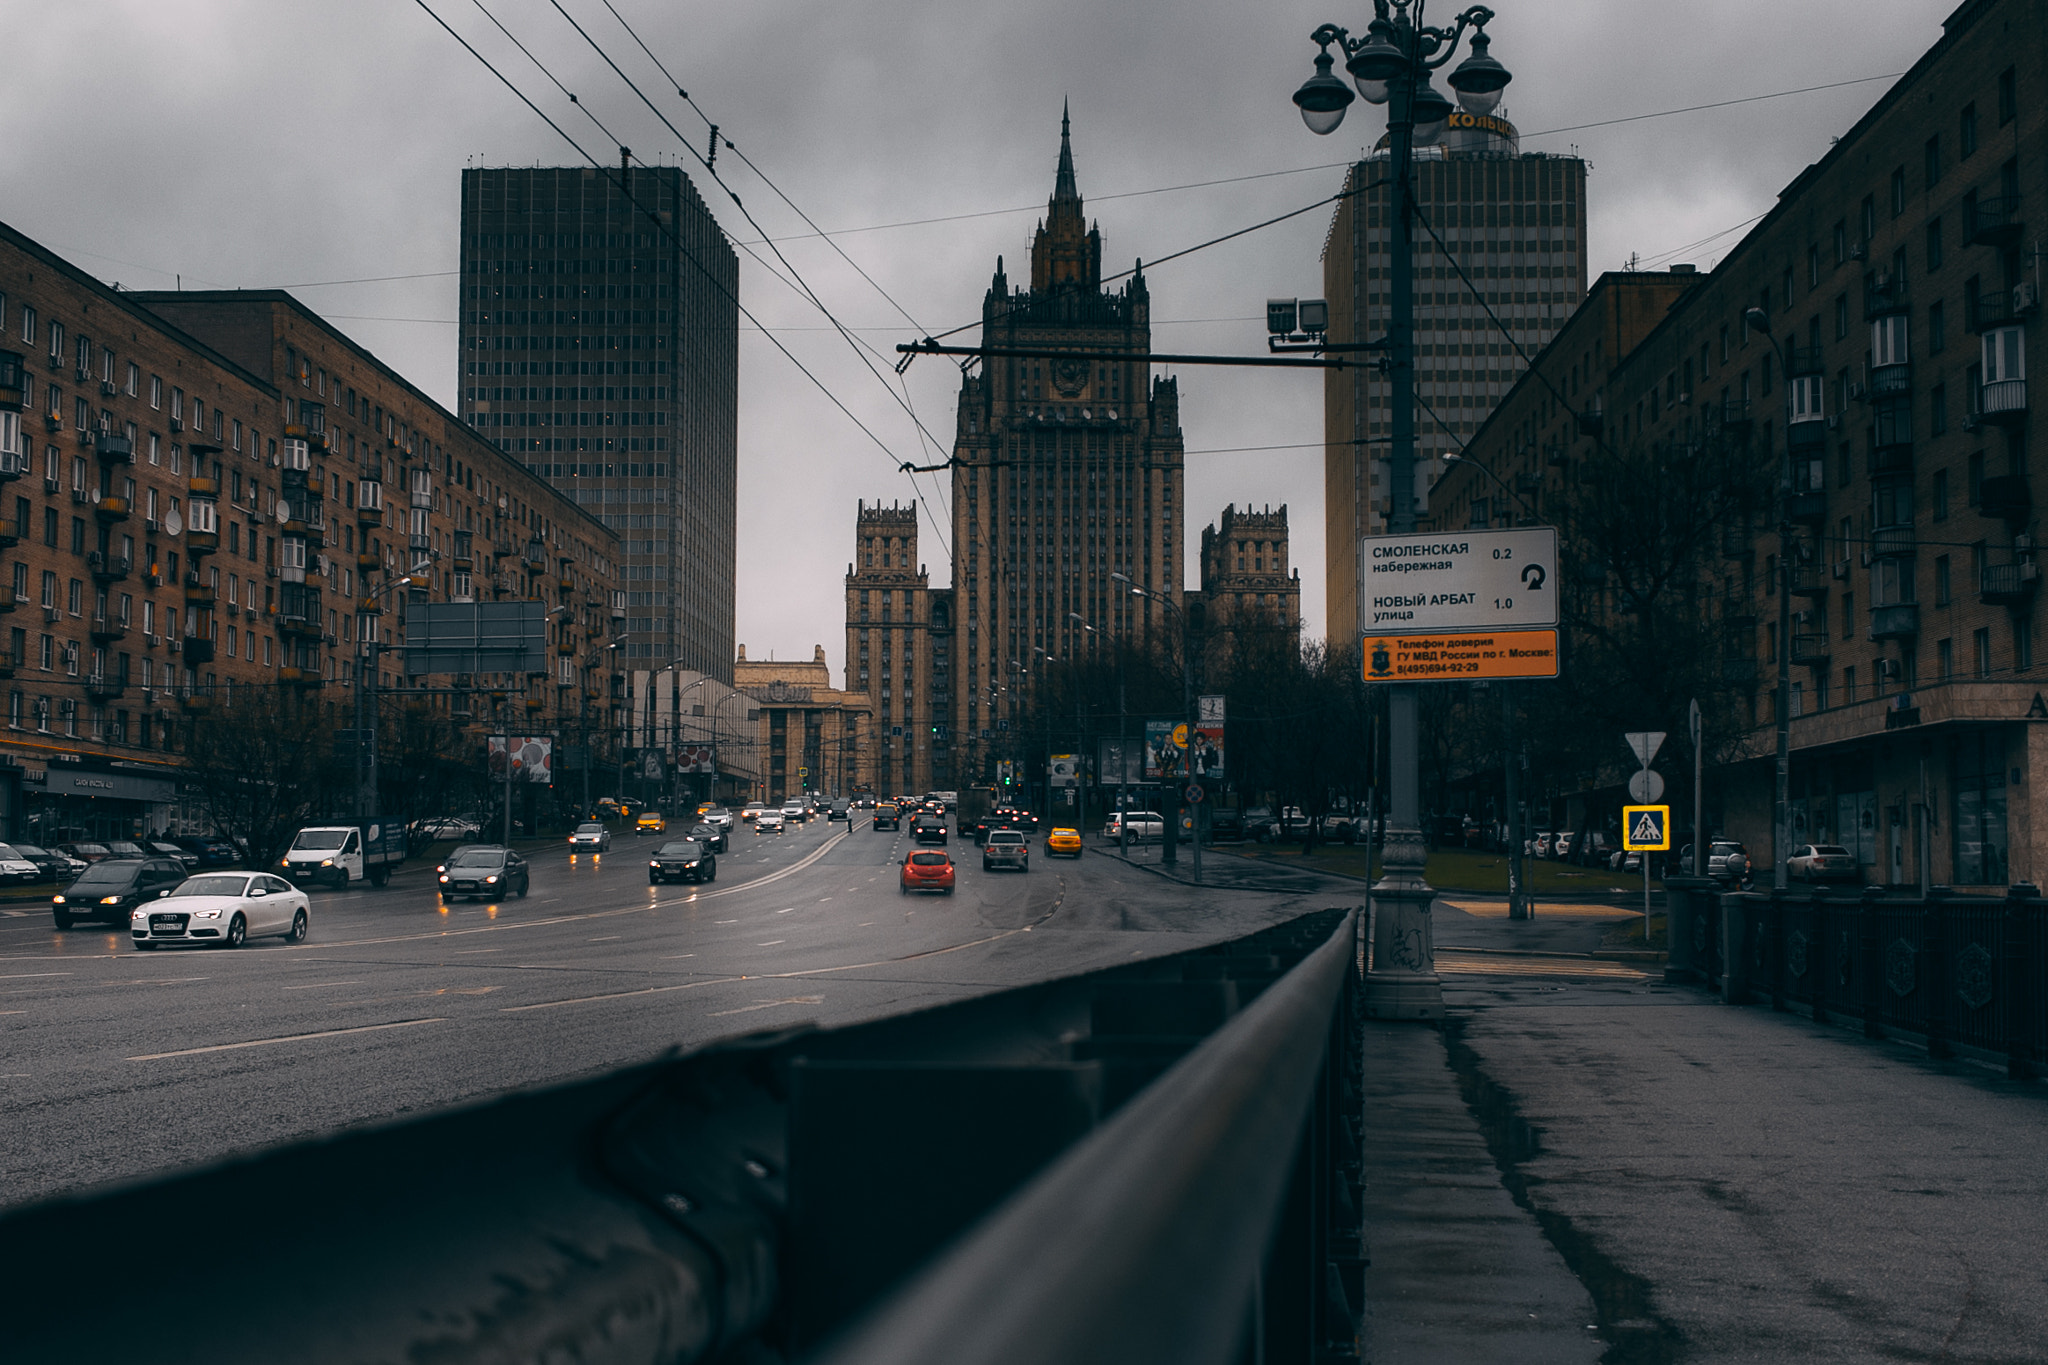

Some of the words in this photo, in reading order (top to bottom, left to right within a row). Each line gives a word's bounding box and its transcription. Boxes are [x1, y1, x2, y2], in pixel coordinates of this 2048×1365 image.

[1373, 543, 1469, 558] СМОЛЕНСКАЯ
[1492, 548, 1512, 560] 0.2
[1373, 561, 1453, 574] набережная
[1374, 593, 1426, 608] НОВЫЙ
[1430, 593, 1476, 605] АРБАТ
[1494, 598, 1513, 609] 1.0
[1373, 610, 1414, 623] улица
[1397, 640, 1444, 650] Телефон
[1447, 639, 1494, 649] доверия
[1397, 652, 1409, 661] ГУ
[1413, 651, 1438, 661] МВД
[1441, 650, 1480, 660] России
[1483, 651, 1497, 659] по
[1509, 648, 1554, 658] Москве:
[1397, 662, 1479, 675] 8(495)694-92-29
